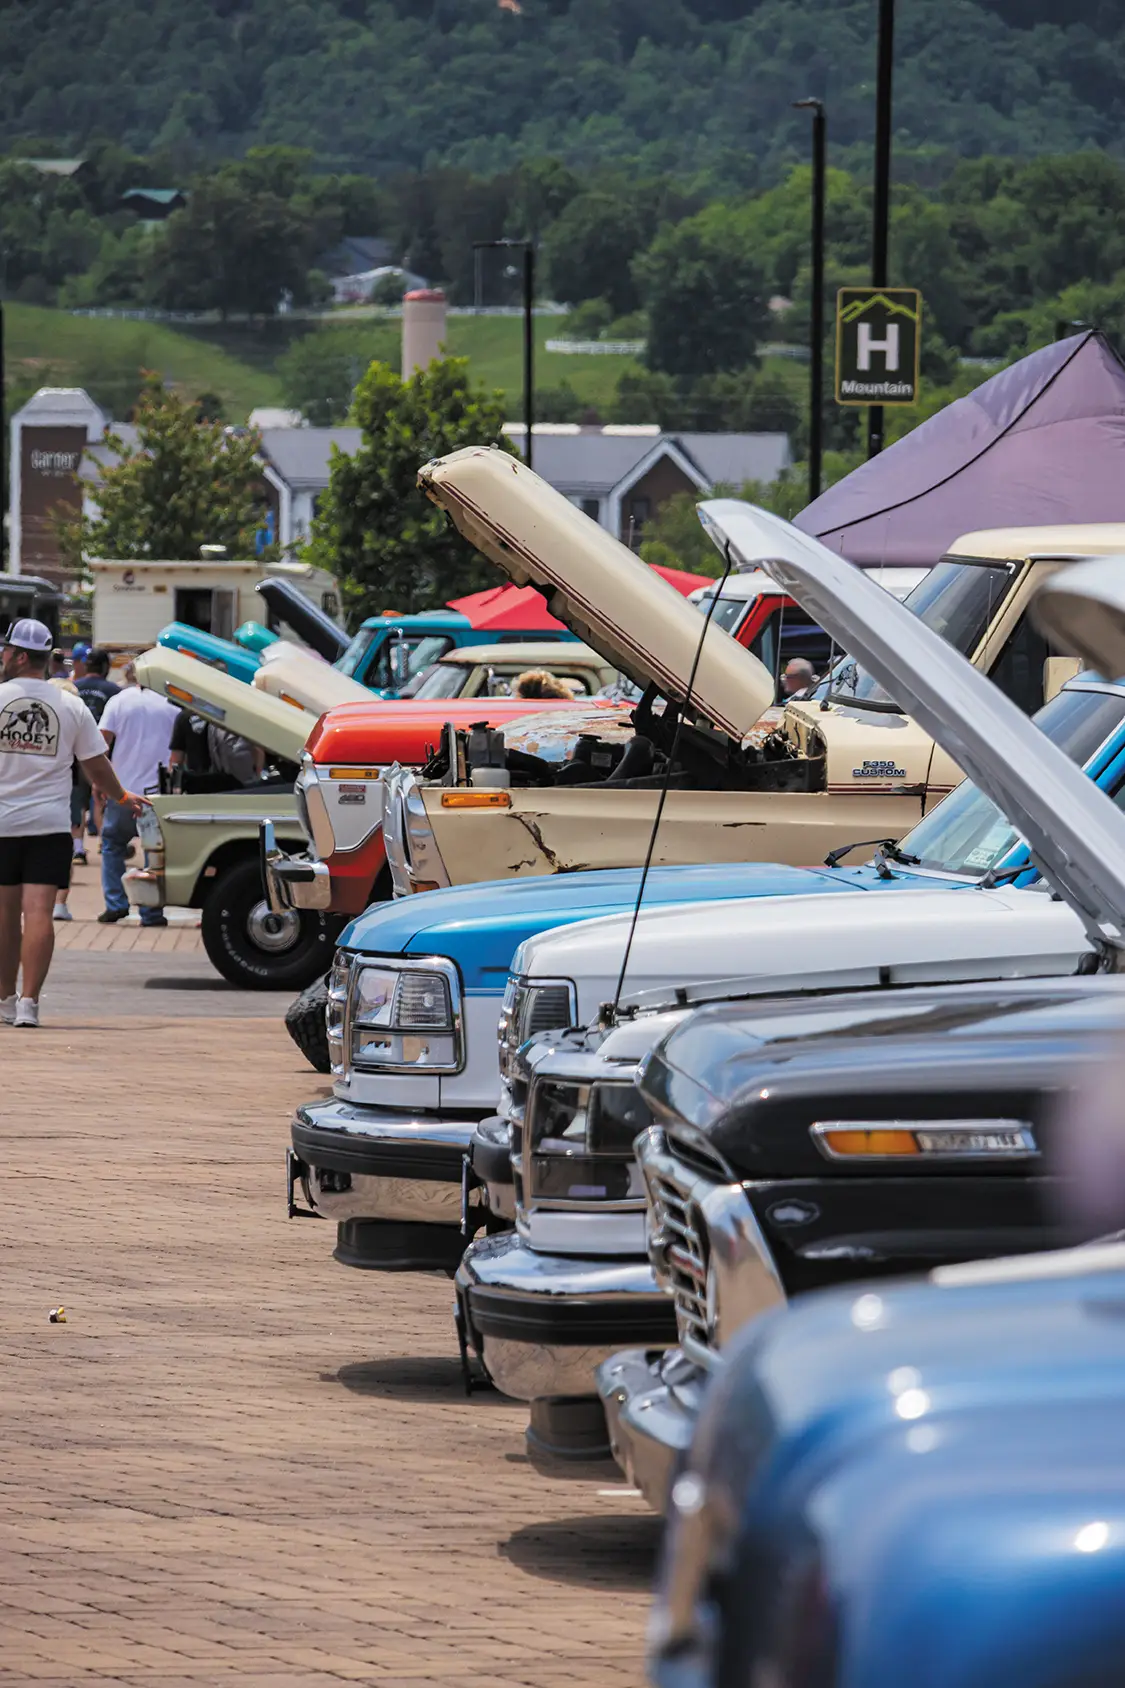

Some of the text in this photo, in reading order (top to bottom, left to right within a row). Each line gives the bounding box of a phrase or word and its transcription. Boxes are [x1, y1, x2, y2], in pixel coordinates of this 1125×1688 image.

[857, 322, 899, 371] H
[841, 380, 913, 395] Mountain
[0, 731, 55, 744] HOOEY
[862, 760, 896, 768] F350
[852, 768, 906, 777] CUSTOM
